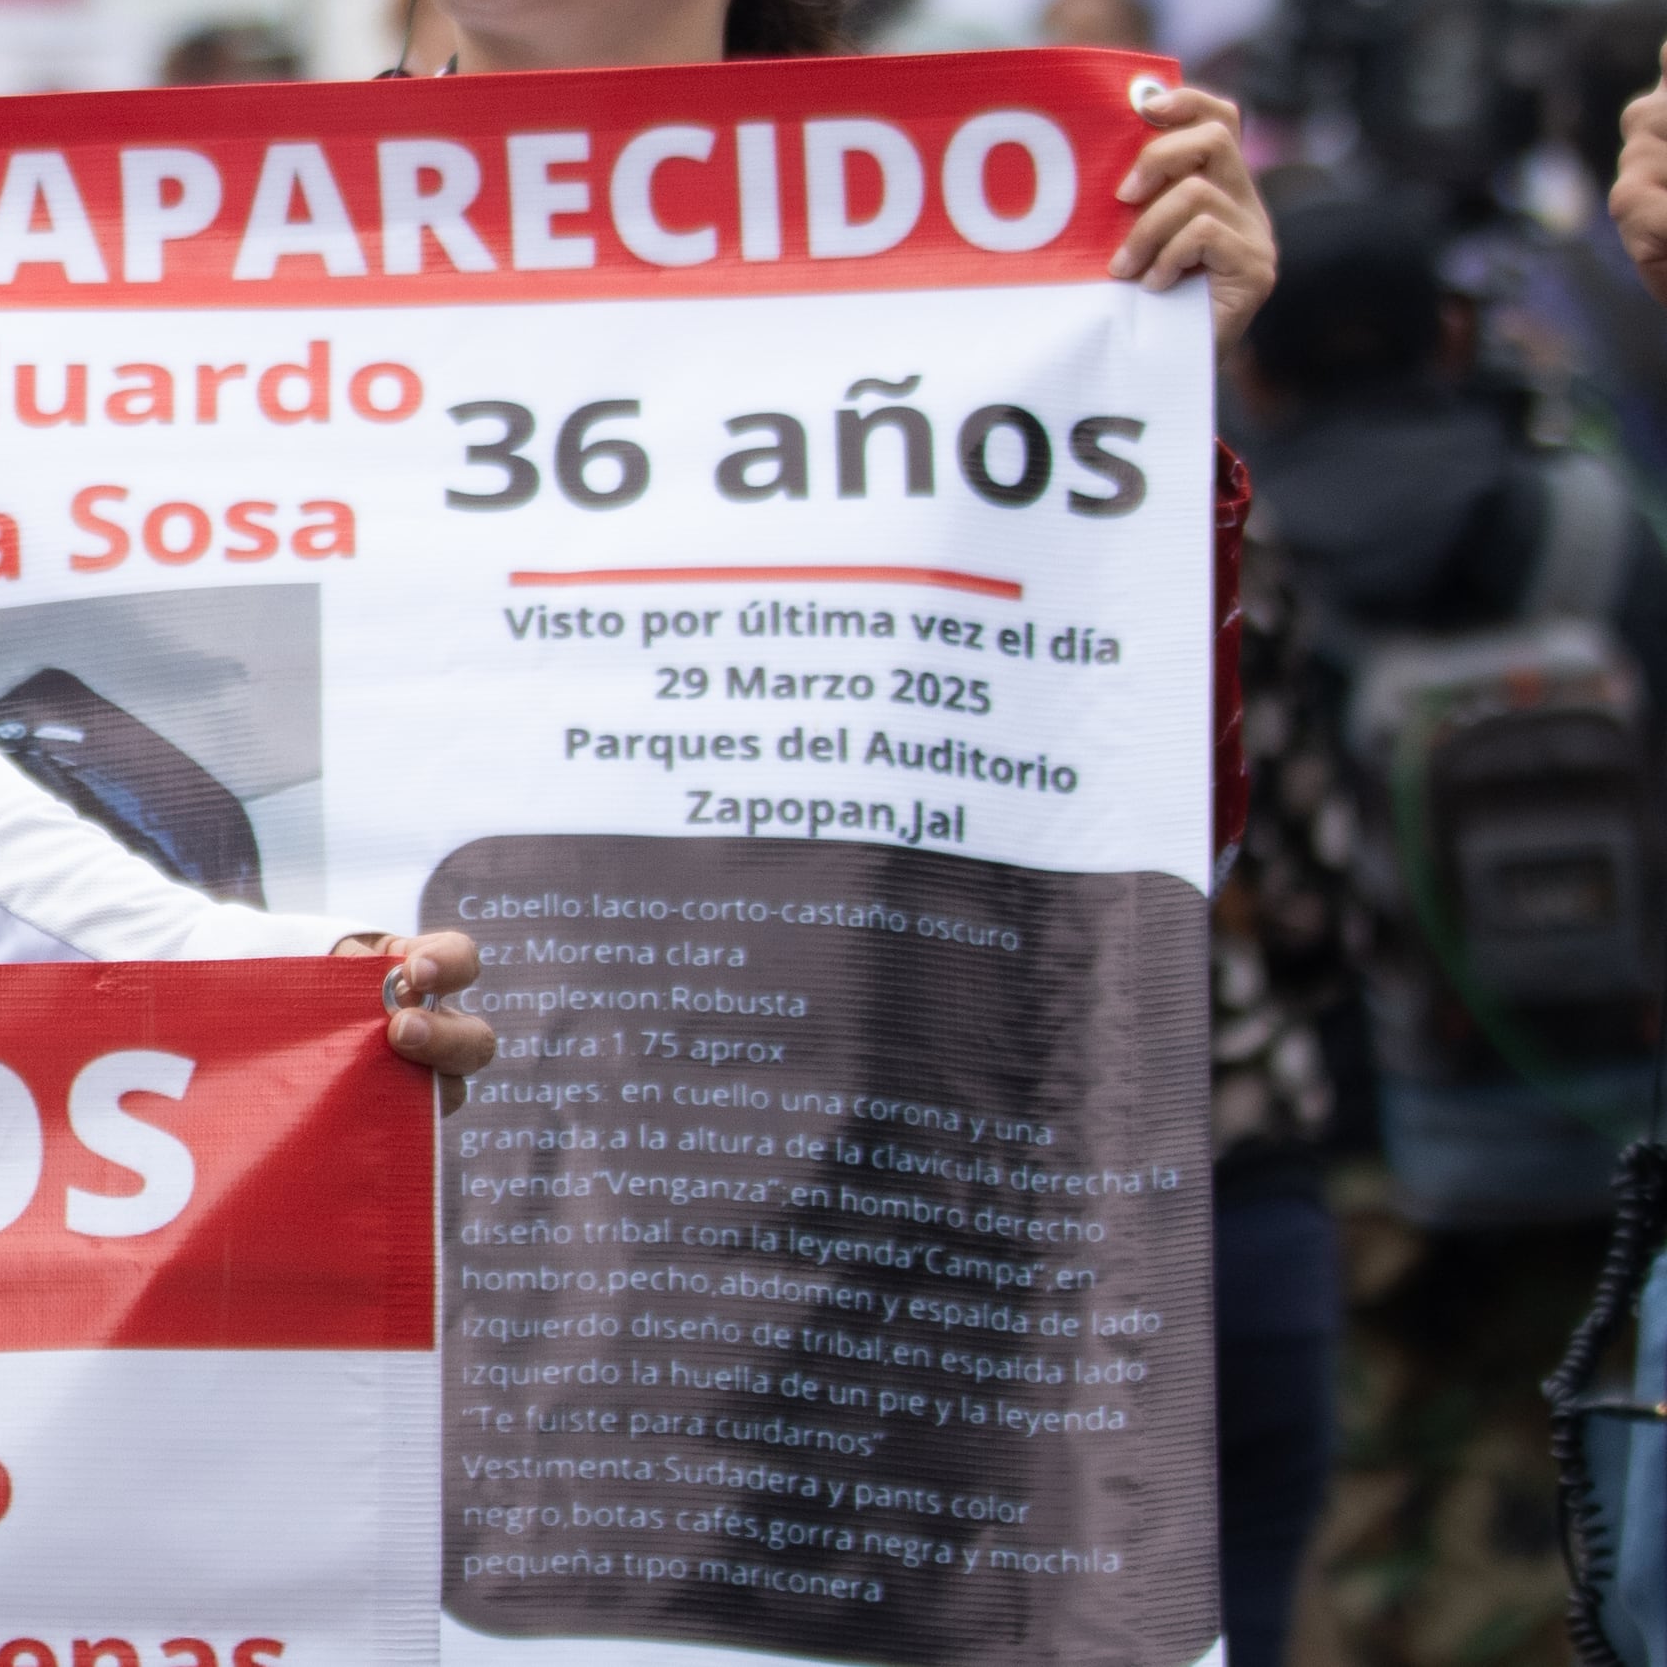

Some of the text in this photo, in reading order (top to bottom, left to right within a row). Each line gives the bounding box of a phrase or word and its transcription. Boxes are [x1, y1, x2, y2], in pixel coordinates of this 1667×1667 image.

[443, 373, 1149, 520] 36 años
[67, 483, 359, 575] Sosa
[503, 601, 1122, 666] Visto por última vez el día
[654, 666, 992, 715] 29 Marzo 2025
[563, 726, 1078, 794] Parques del Auditorio
[685, 790, 966, 845] Zapopan,Jal
[477, 939, 747, 967] ez:Morena clara
[917, 916, 1018, 952] oscuro
[496, 1032, 786, 1067] tatura:1.75 aprox
[465, 1080, 1055, 1146] Tatuajes: en cuello una corona y una
[640, 1123, 667, 1150] la
[677, 1126, 774, 1157] altura
[785, 1131, 828, 1161] de
[835, 1136, 864, 1166] la
[1010, 1165, 1144, 1196] derecha
[1151, 1165, 1180, 1191] la
[460, 1215, 572, 1246] diseño
[583, 1217, 671, 1245] tribal
[681, 1223, 740, 1247] con
[751, 1222, 778, 1253] la
[840, 1185, 965, 1229] hombro
[973, 1205, 1106, 1244] derecho
[883, 1294, 900, 1322] y
[909, 1296, 1030, 1334] espalda
[1039, 1310, 1080, 1337] de
[1092, 1309, 1163, 1336] lado
[462, 1312, 620, 1343] izquierdo
[630, 1311, 741, 1344] diseño
[751, 1320, 792, 1349] de
[941, 1347, 1064, 1385] espalda
[1074, 1357, 1148, 1386] lado
[462, 1358, 1126, 1437] izquierdo la huella de un pie y la leyenda
[525, 1405, 618, 1433] fuiste
[629, 1413, 705, 1440] para
[827, 1482, 845, 1508] y
[854, 1483, 942, 1513] pants
[951, 1495, 1031, 1524] color
[463, 1549, 884, 1603] pequeña tipo mariconera
[863, 1531, 954, 1568] negra
[961, 1548, 981, 1575] y
[990, 1547, 1123, 1575] mochila
